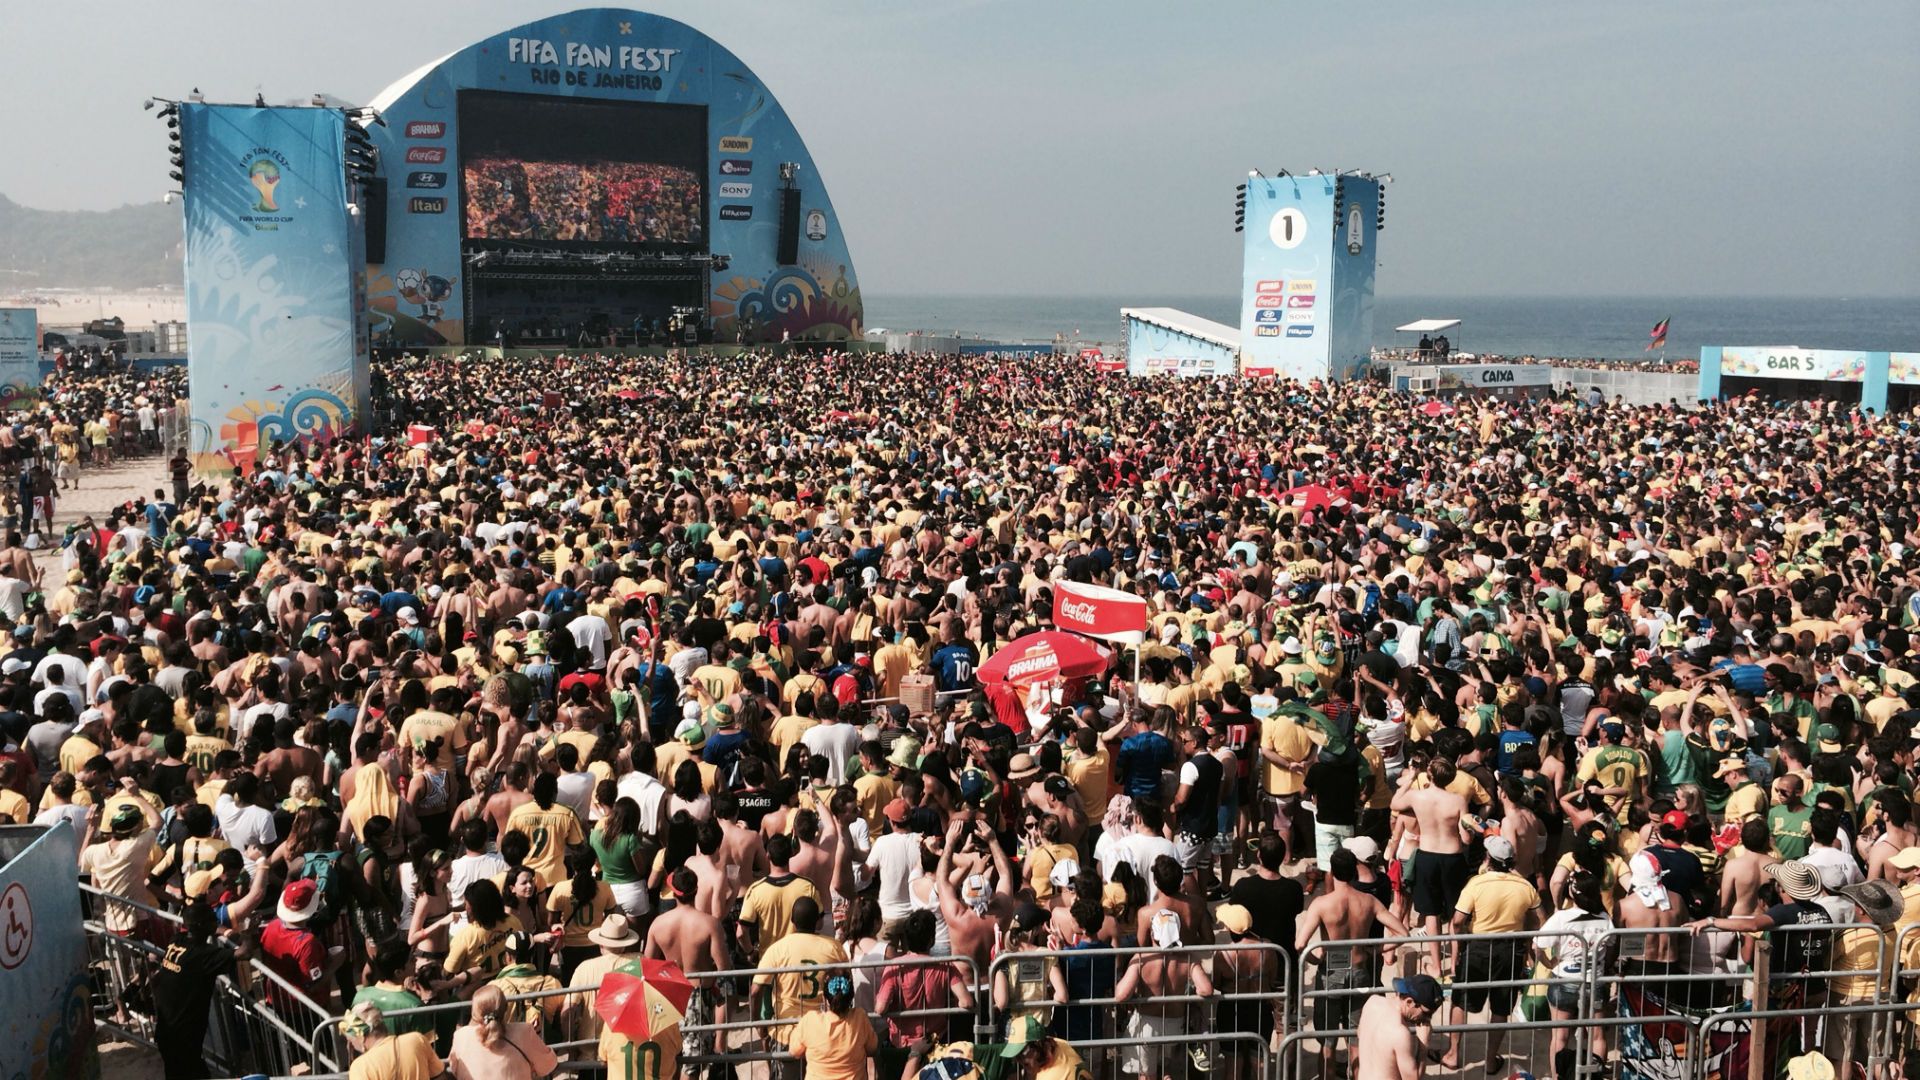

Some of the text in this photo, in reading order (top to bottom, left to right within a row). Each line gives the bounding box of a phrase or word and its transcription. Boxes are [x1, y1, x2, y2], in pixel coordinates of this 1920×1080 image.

[508, 37, 677, 72] FIFA FAN FEST
[531, 68, 663, 91] RIO DE JANEIRO
[411, 124, 440, 135] BRAHMA
[721, 186, 751, 194] SONY
[413, 199, 442, 211] Itaú
[1283, 215, 1293, 241] 1
[1259, 326, 1278, 336] Itaú
[1767, 355, 1800, 371] BAR
[1482, 369, 1514, 383] CAIXA
[1061, 597, 1097, 625] Coca-Cola
[954, 660, 970, 682] 10
[1008, 652, 1059, 680] BRAHMA
[706, 679, 725, 701] 10
[1227, 724, 1247, 750] 10
[745, 798, 772, 807] SAGRES
[799, 959, 819, 999] 3
[620, 1040, 662, 1080] 10
